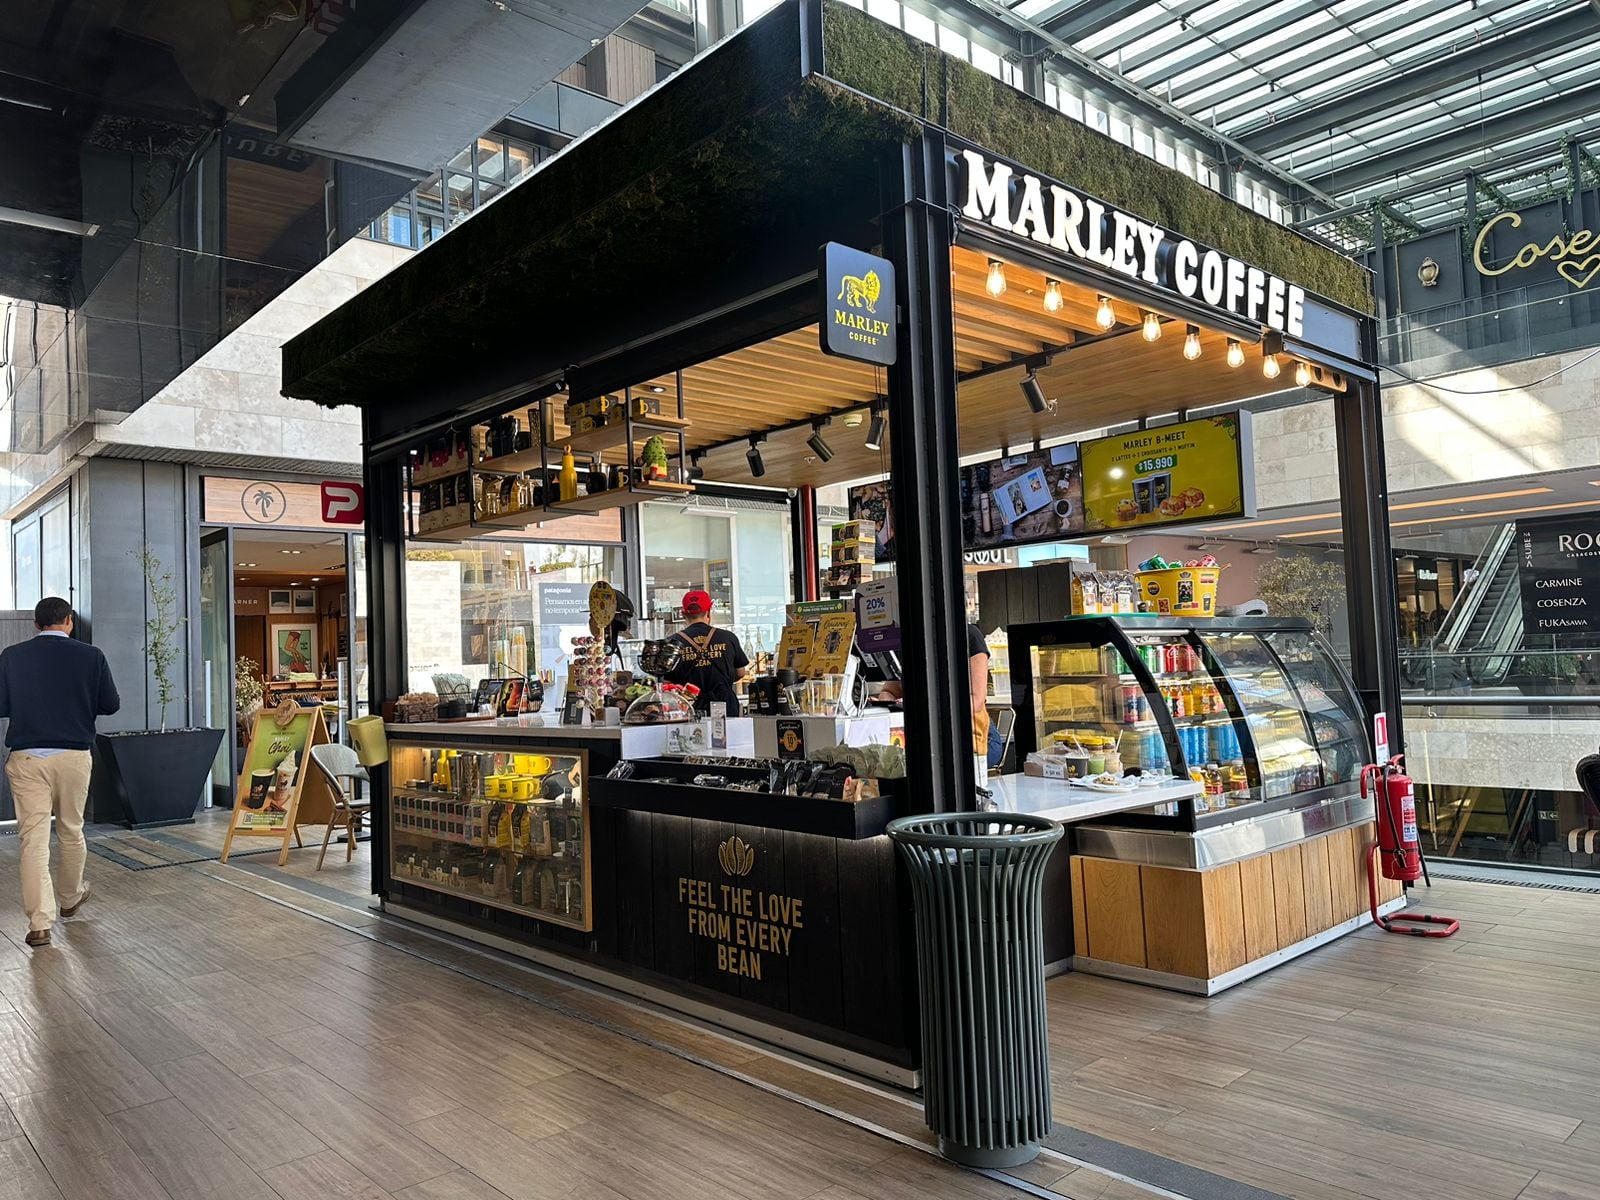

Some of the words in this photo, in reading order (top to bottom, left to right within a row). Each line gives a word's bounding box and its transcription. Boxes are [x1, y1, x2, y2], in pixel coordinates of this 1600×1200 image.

[962, 149, 1165, 284] MARLEY
[1174, 240, 1305, 338] COFFEE
[1473, 211, 1600, 276] Cose
[834, 309, 889, 337] MARLEY
[849, 331, 877, 346] COFFEE
[1123, 436, 1153, 450] MARLEY
[1156, 430, 1186, 444] B-MEET
[1115, 454, 1132, 462] LATTES
[1141, 448, 1168, 457] CROISSANTS
[1138, 456, 1173, 471] $15.990
[1523, 538, 1533, 560] SUBE
[1535, 577, 1583, 589] CARMINE
[866, 597, 886, 610] 20%
[1536, 597, 1587, 608] COSENZA
[709, 643, 727, 652] LOVE
[679, 877, 716, 909] FEEL
[720, 884, 753, 917] THE
[759, 891, 803, 929] LOVE
[688, 908, 731, 942] FROM
[736, 918, 792, 957] EVERY
[717, 943, 761, 981] BEAN
